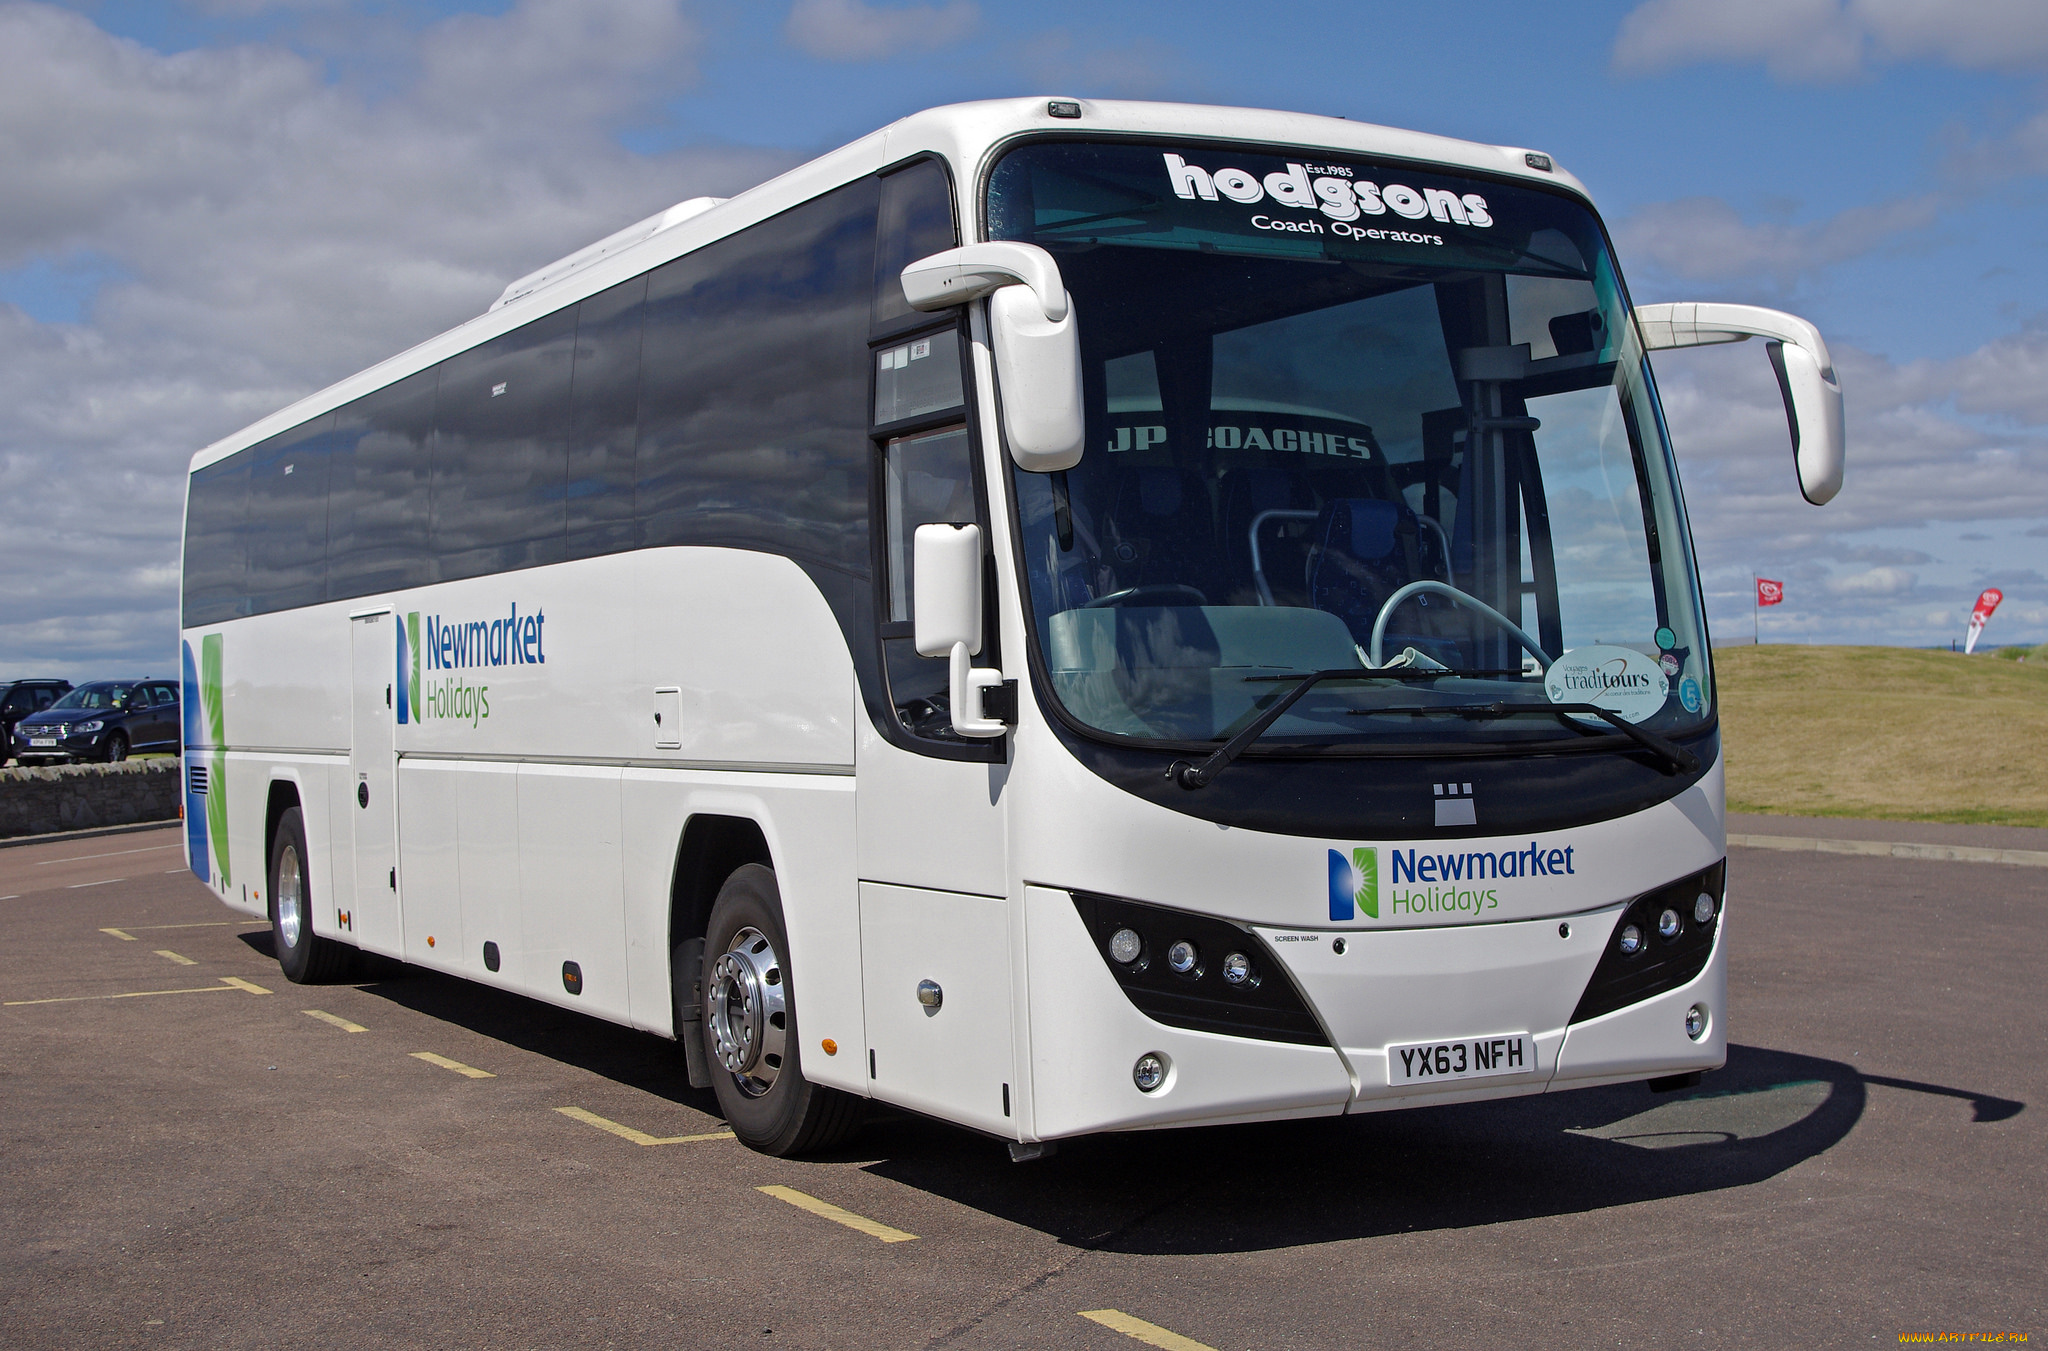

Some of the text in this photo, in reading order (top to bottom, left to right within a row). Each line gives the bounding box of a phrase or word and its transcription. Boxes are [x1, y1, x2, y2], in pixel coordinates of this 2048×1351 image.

[1305, 163, 1354, 178] Est.1985
[1163, 152, 1494, 229] hodgsons
[1250, 214, 1444, 247] Coach Operators
[1107, 425, 1371, 460] JP OACHES
[427, 601, 545, 670] Newmarket
[1563, 668, 1650, 690] traditours
[427, 677, 489, 729] Holidays
[1686, 687, 1697, 708] 5
[1391, 841, 1575, 884] Newmarket
[1392, 886, 1498, 916] Holidays
[1400, 1038, 1523, 1078] YX63 NFH
